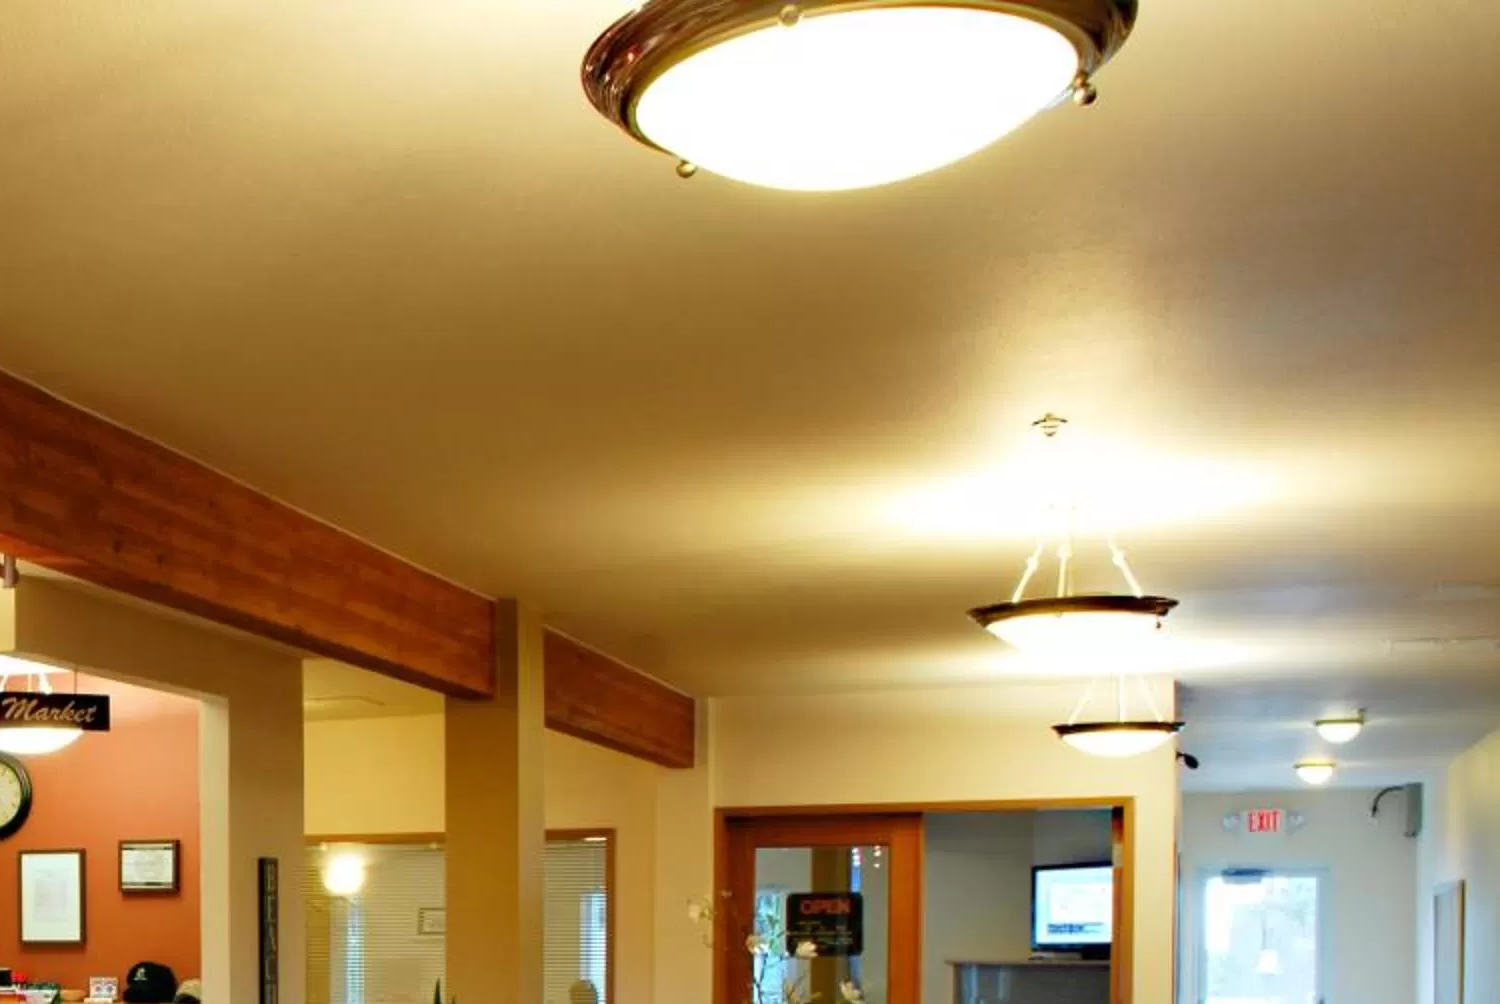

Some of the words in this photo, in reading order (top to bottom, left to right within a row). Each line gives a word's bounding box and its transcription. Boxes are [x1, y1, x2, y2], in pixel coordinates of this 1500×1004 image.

[2, 697, 96, 723] Market
[1247, 811, 1280, 832] EXIT
[801, 899, 851, 914] OPEN
